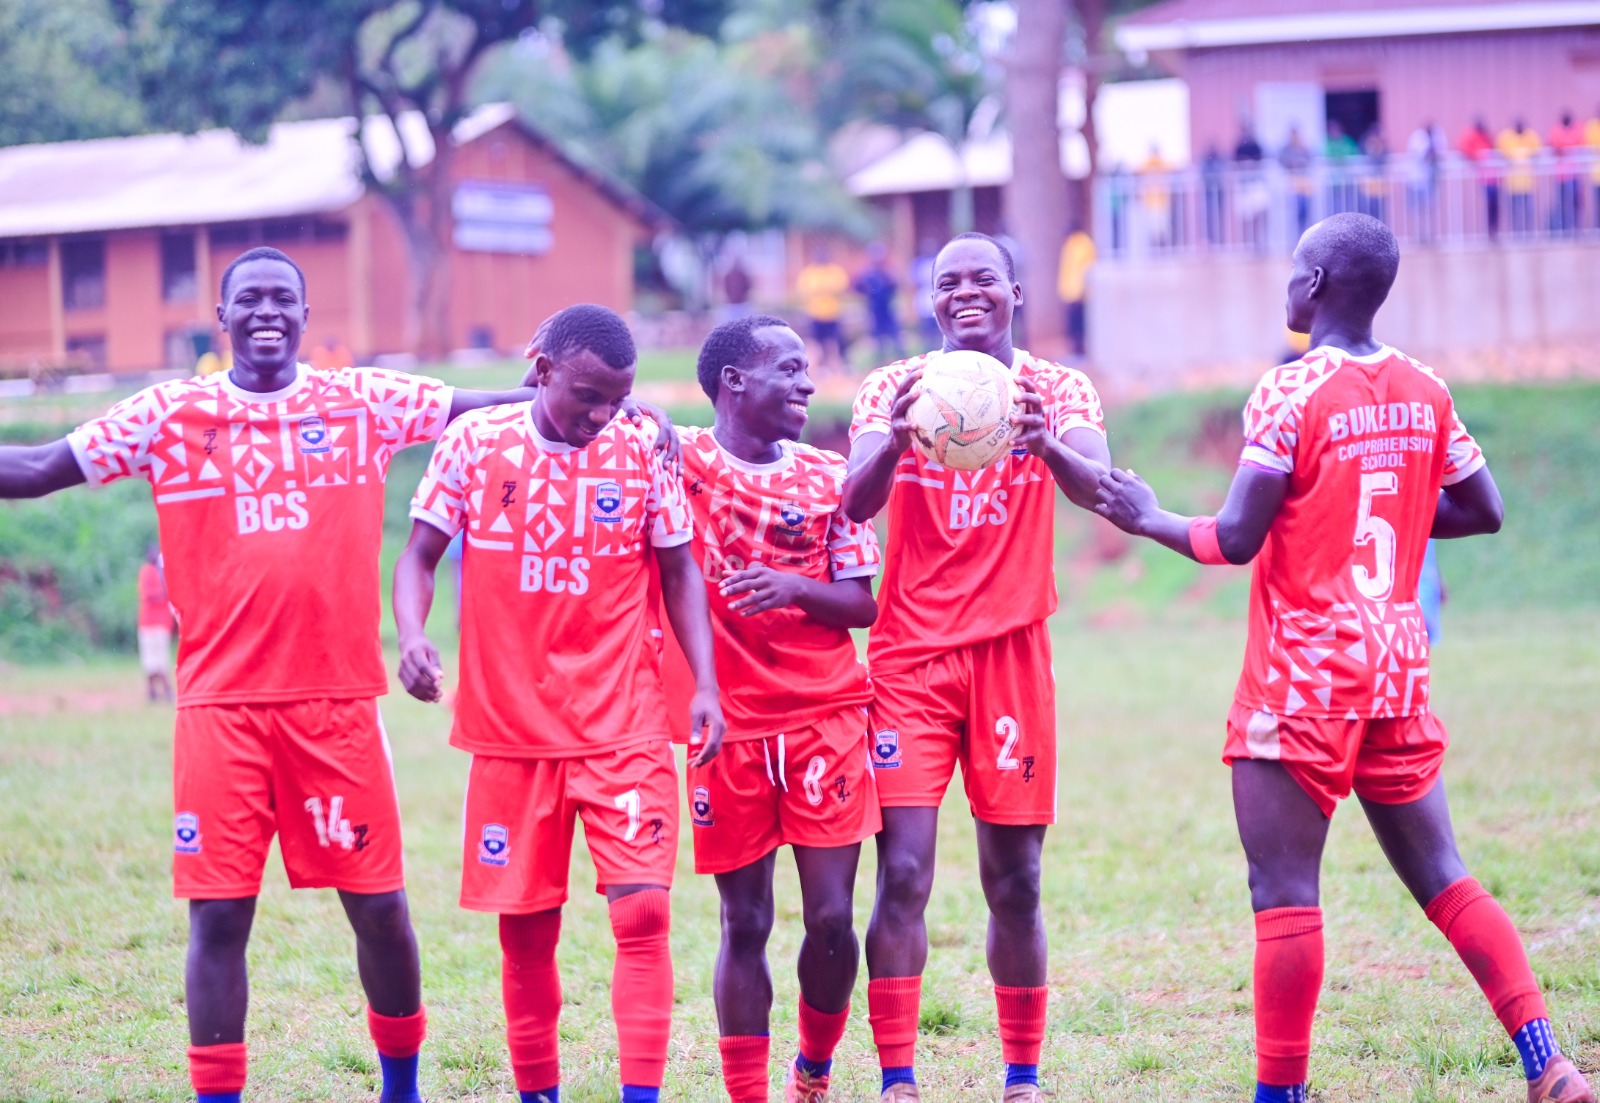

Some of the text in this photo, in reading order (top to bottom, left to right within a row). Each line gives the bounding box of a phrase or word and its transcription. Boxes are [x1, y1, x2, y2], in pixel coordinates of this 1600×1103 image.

[1328, 402, 1438, 441] BUKEDEA
[235, 490, 309, 535] BCS
[949, 489, 1008, 530] BCS
[1351, 471, 1399, 602] 5
[520, 554, 590, 595] BCS
[995, 715, 1020, 770] 2
[803, 755, 826, 806] 8
[304, 795, 355, 850] 14
[614, 789, 640, 842] 7
